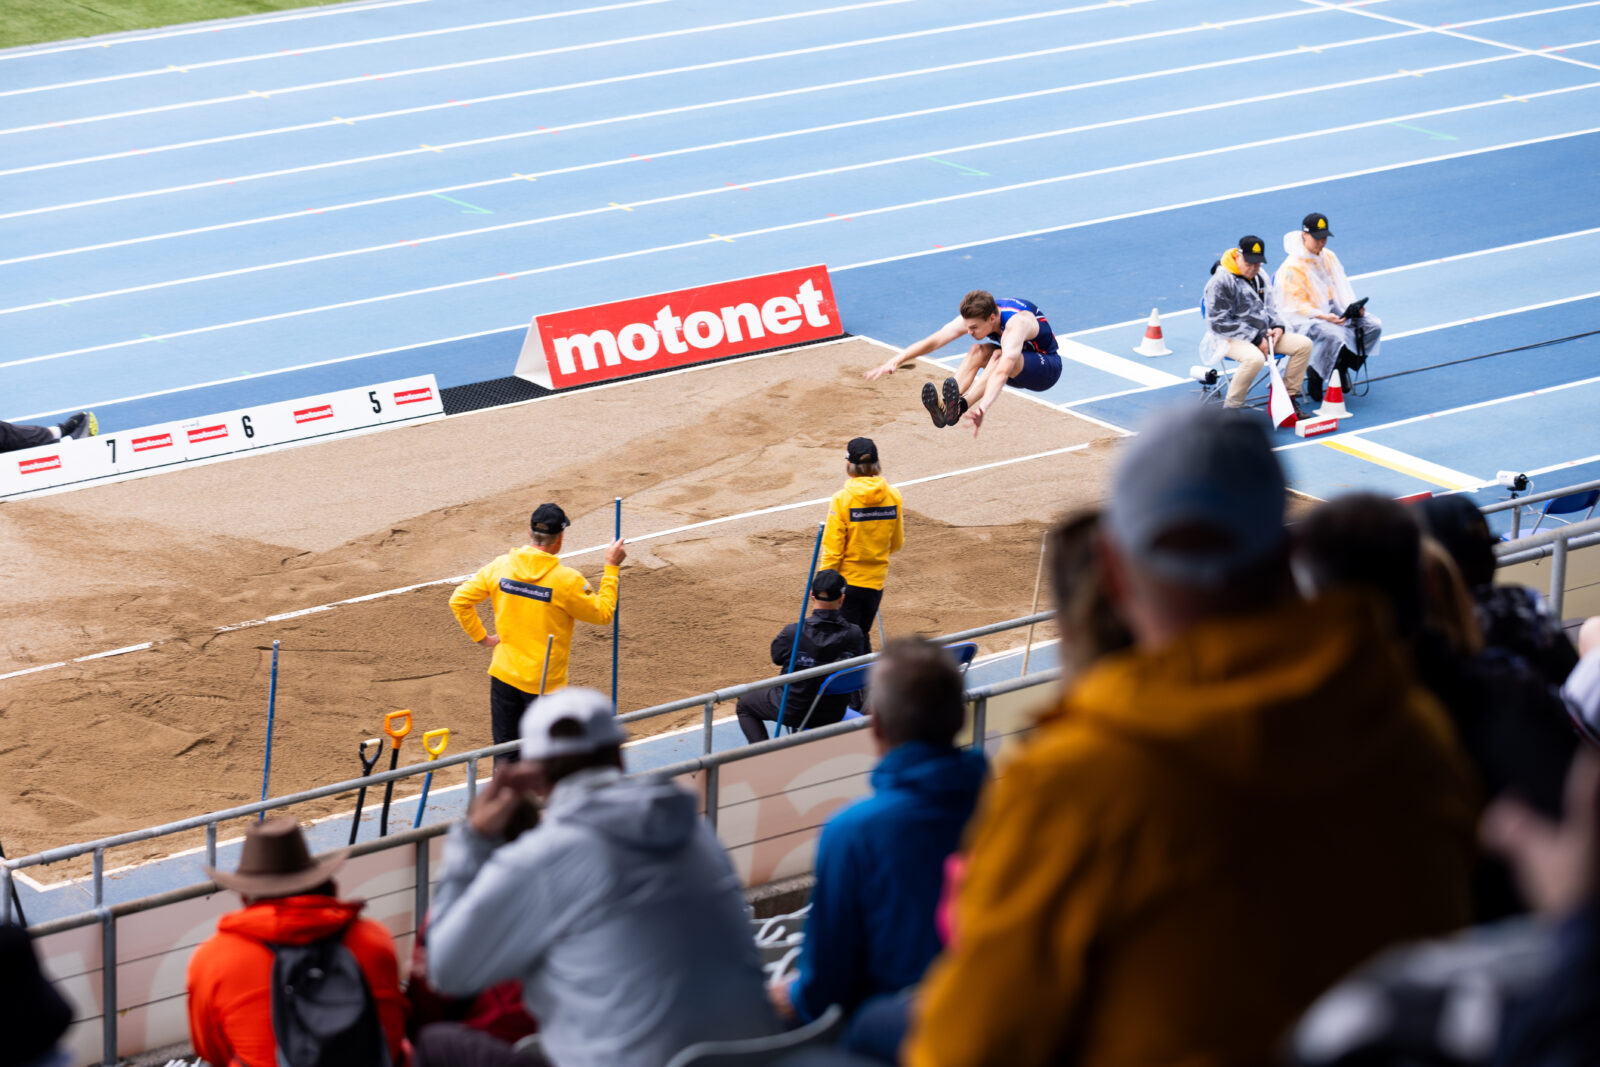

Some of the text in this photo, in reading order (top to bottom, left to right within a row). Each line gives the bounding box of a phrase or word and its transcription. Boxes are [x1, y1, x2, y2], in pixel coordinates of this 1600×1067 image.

[553, 279, 829, 374] motonet
[106, 439, 116, 463] 7
[242, 415, 254, 438] 6
[369, 391, 382, 413] 5
